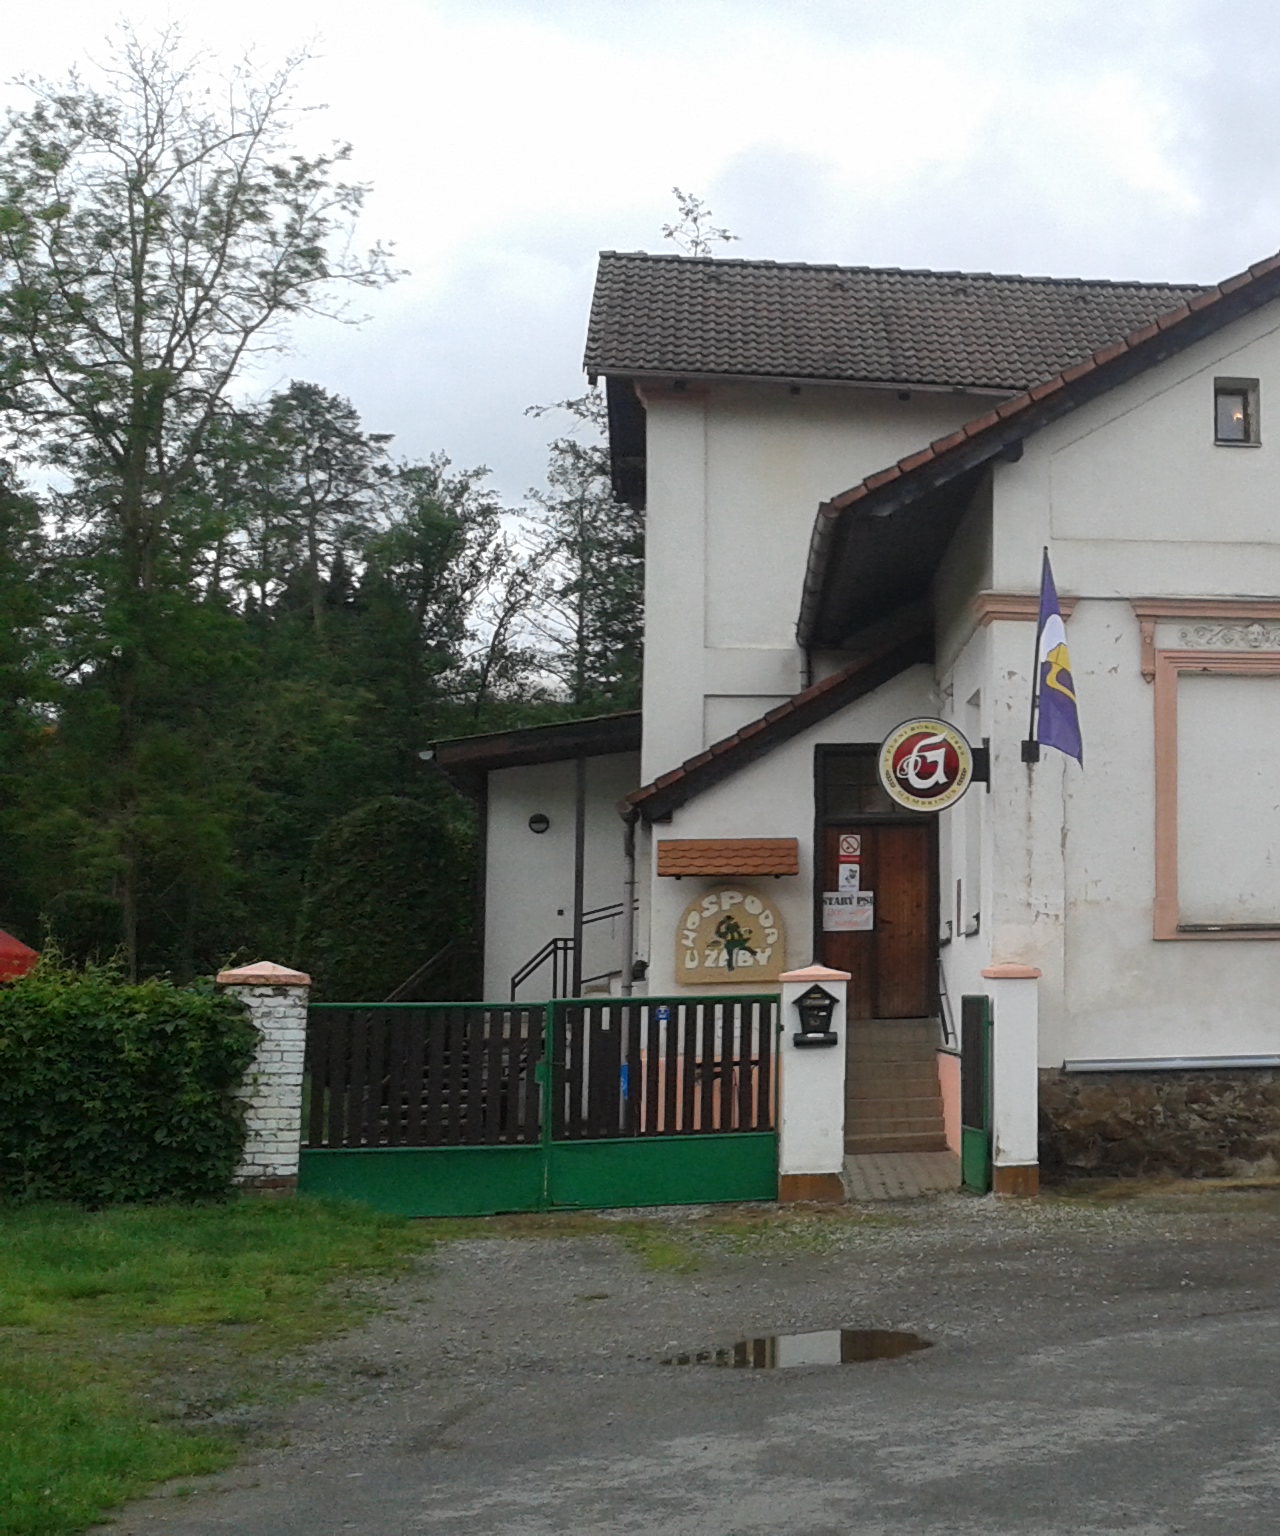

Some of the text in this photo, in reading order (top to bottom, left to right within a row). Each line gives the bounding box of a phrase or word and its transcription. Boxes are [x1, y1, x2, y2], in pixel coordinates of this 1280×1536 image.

[898, 789, 957, 806] GAMBRINUS
[682, 890, 778, 948] HOSPODA
[685, 949, 699, 969] U
